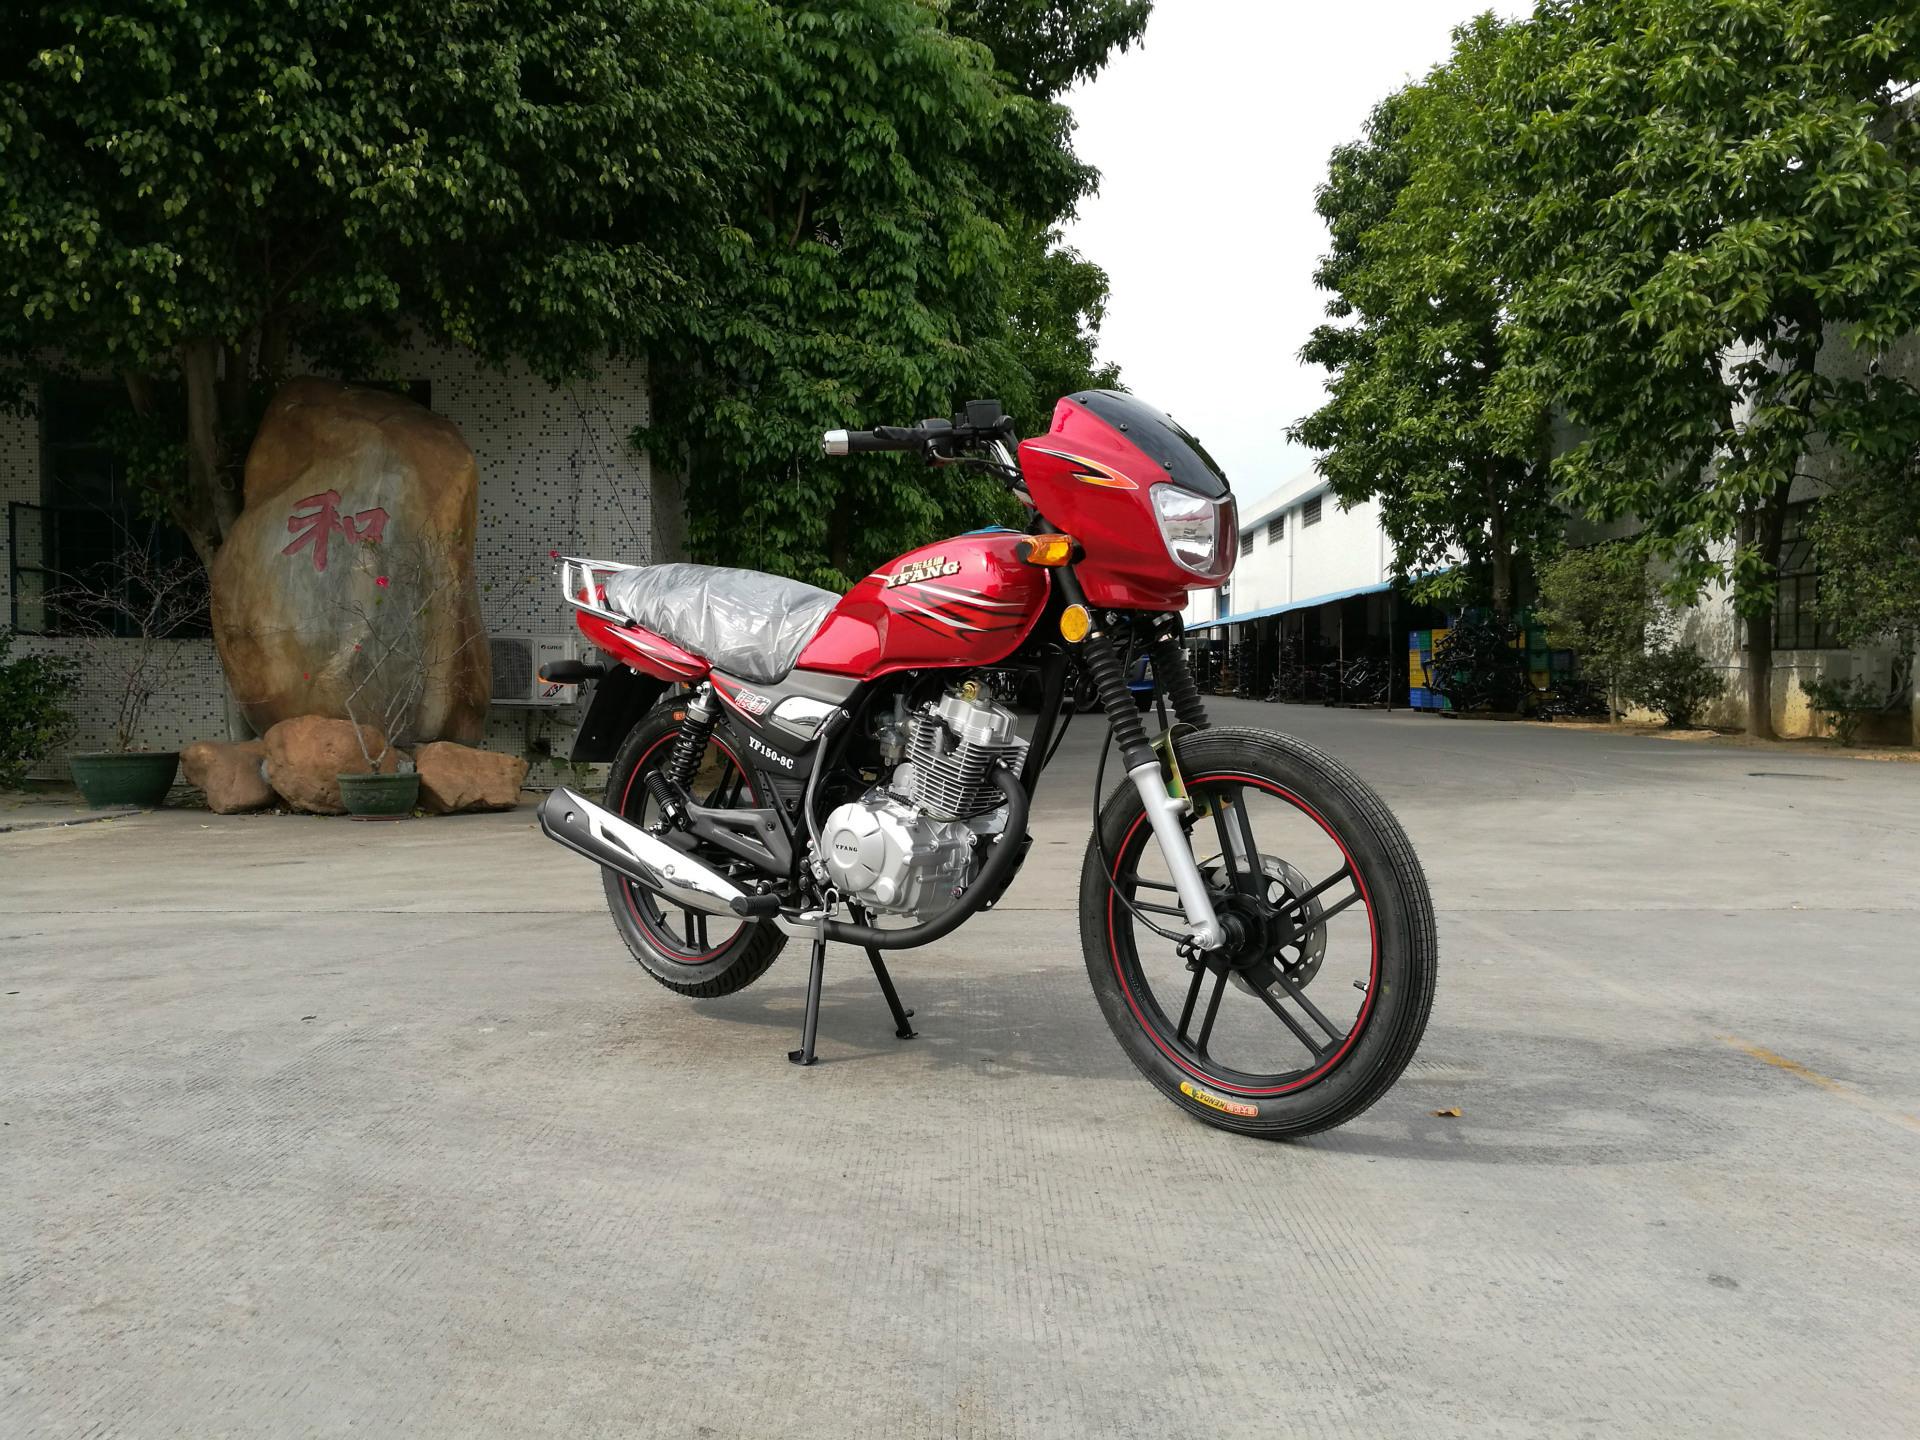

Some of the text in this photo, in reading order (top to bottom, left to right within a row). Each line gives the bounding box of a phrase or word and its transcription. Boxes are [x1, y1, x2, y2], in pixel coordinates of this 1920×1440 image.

[281, 489, 390, 572] 和
[886, 561, 960, 588] YFANG
[749, 736, 794, 769] YF150-8C
[835, 844, 858, 852] YFANG
[1200, 1091, 1226, 1109] KENDA
